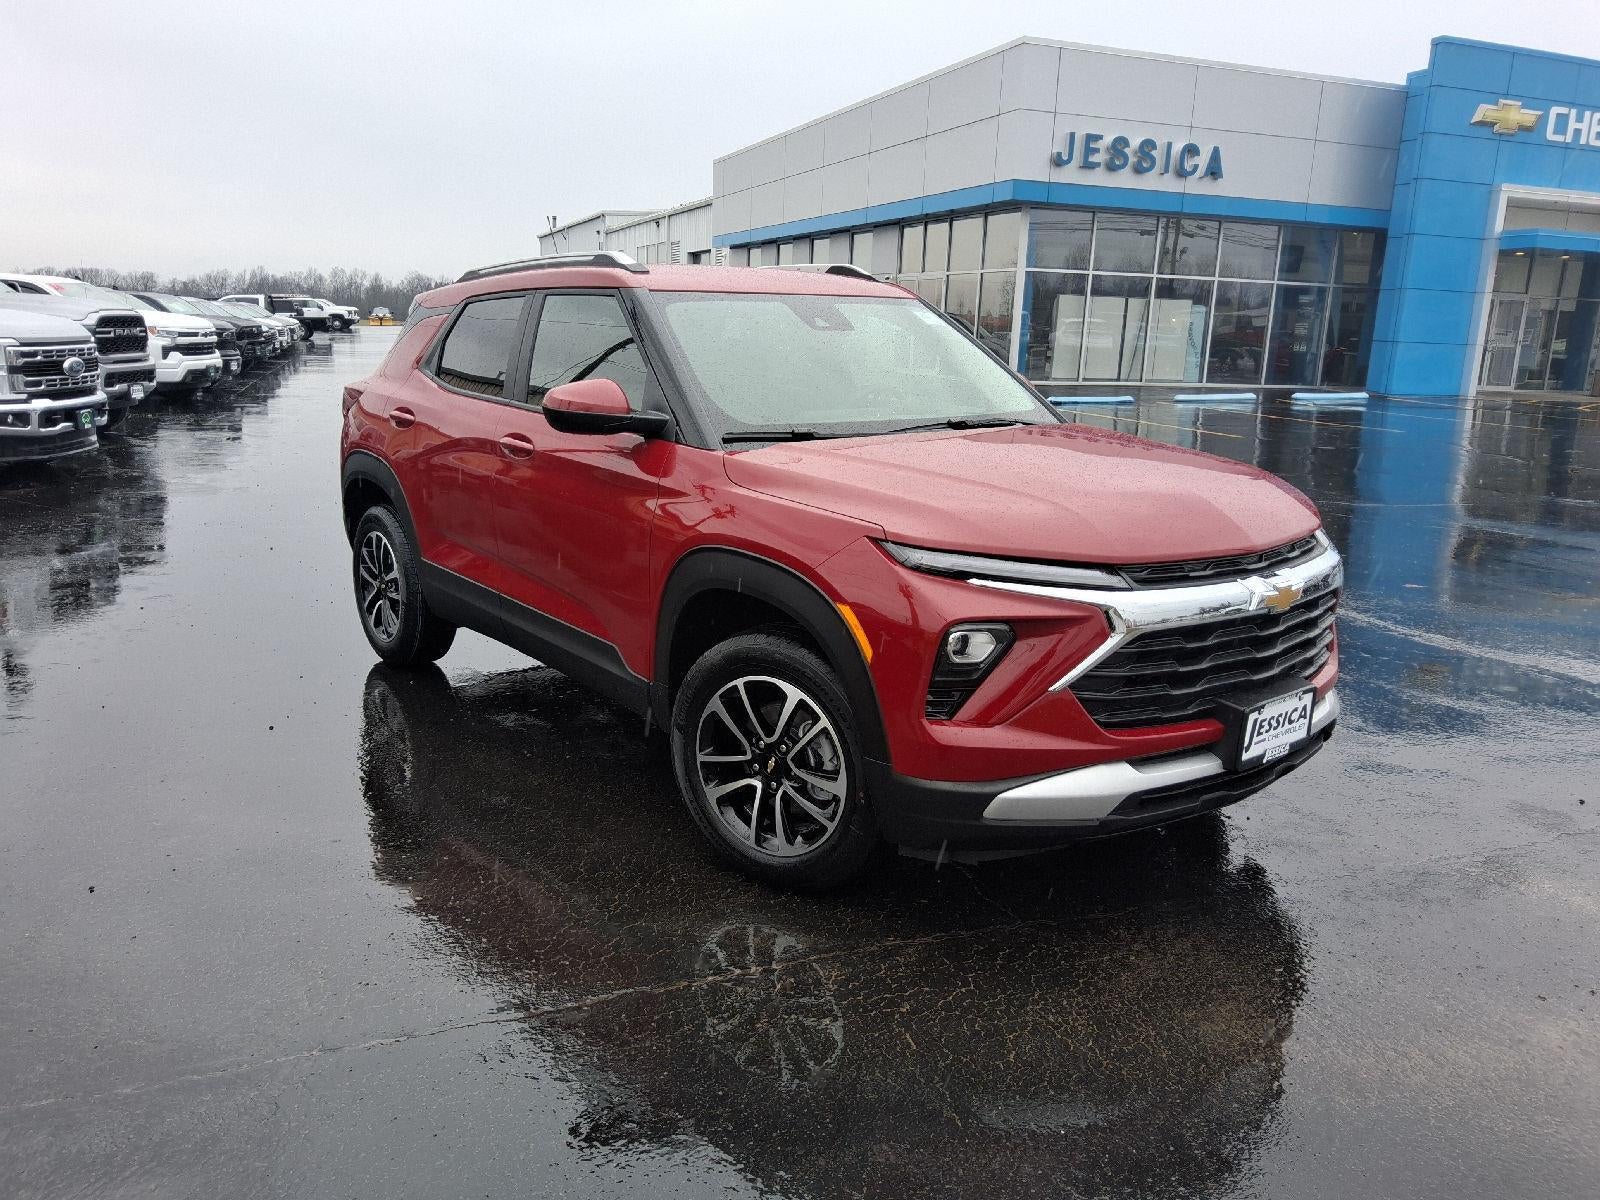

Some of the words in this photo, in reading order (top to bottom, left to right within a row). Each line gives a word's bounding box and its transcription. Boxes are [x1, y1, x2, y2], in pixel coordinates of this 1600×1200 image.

[1053, 131, 1223, 180] JESSICA
[1245, 704, 1308, 753] JESSICA
[1267, 722, 1306, 742] CHEVROLET
